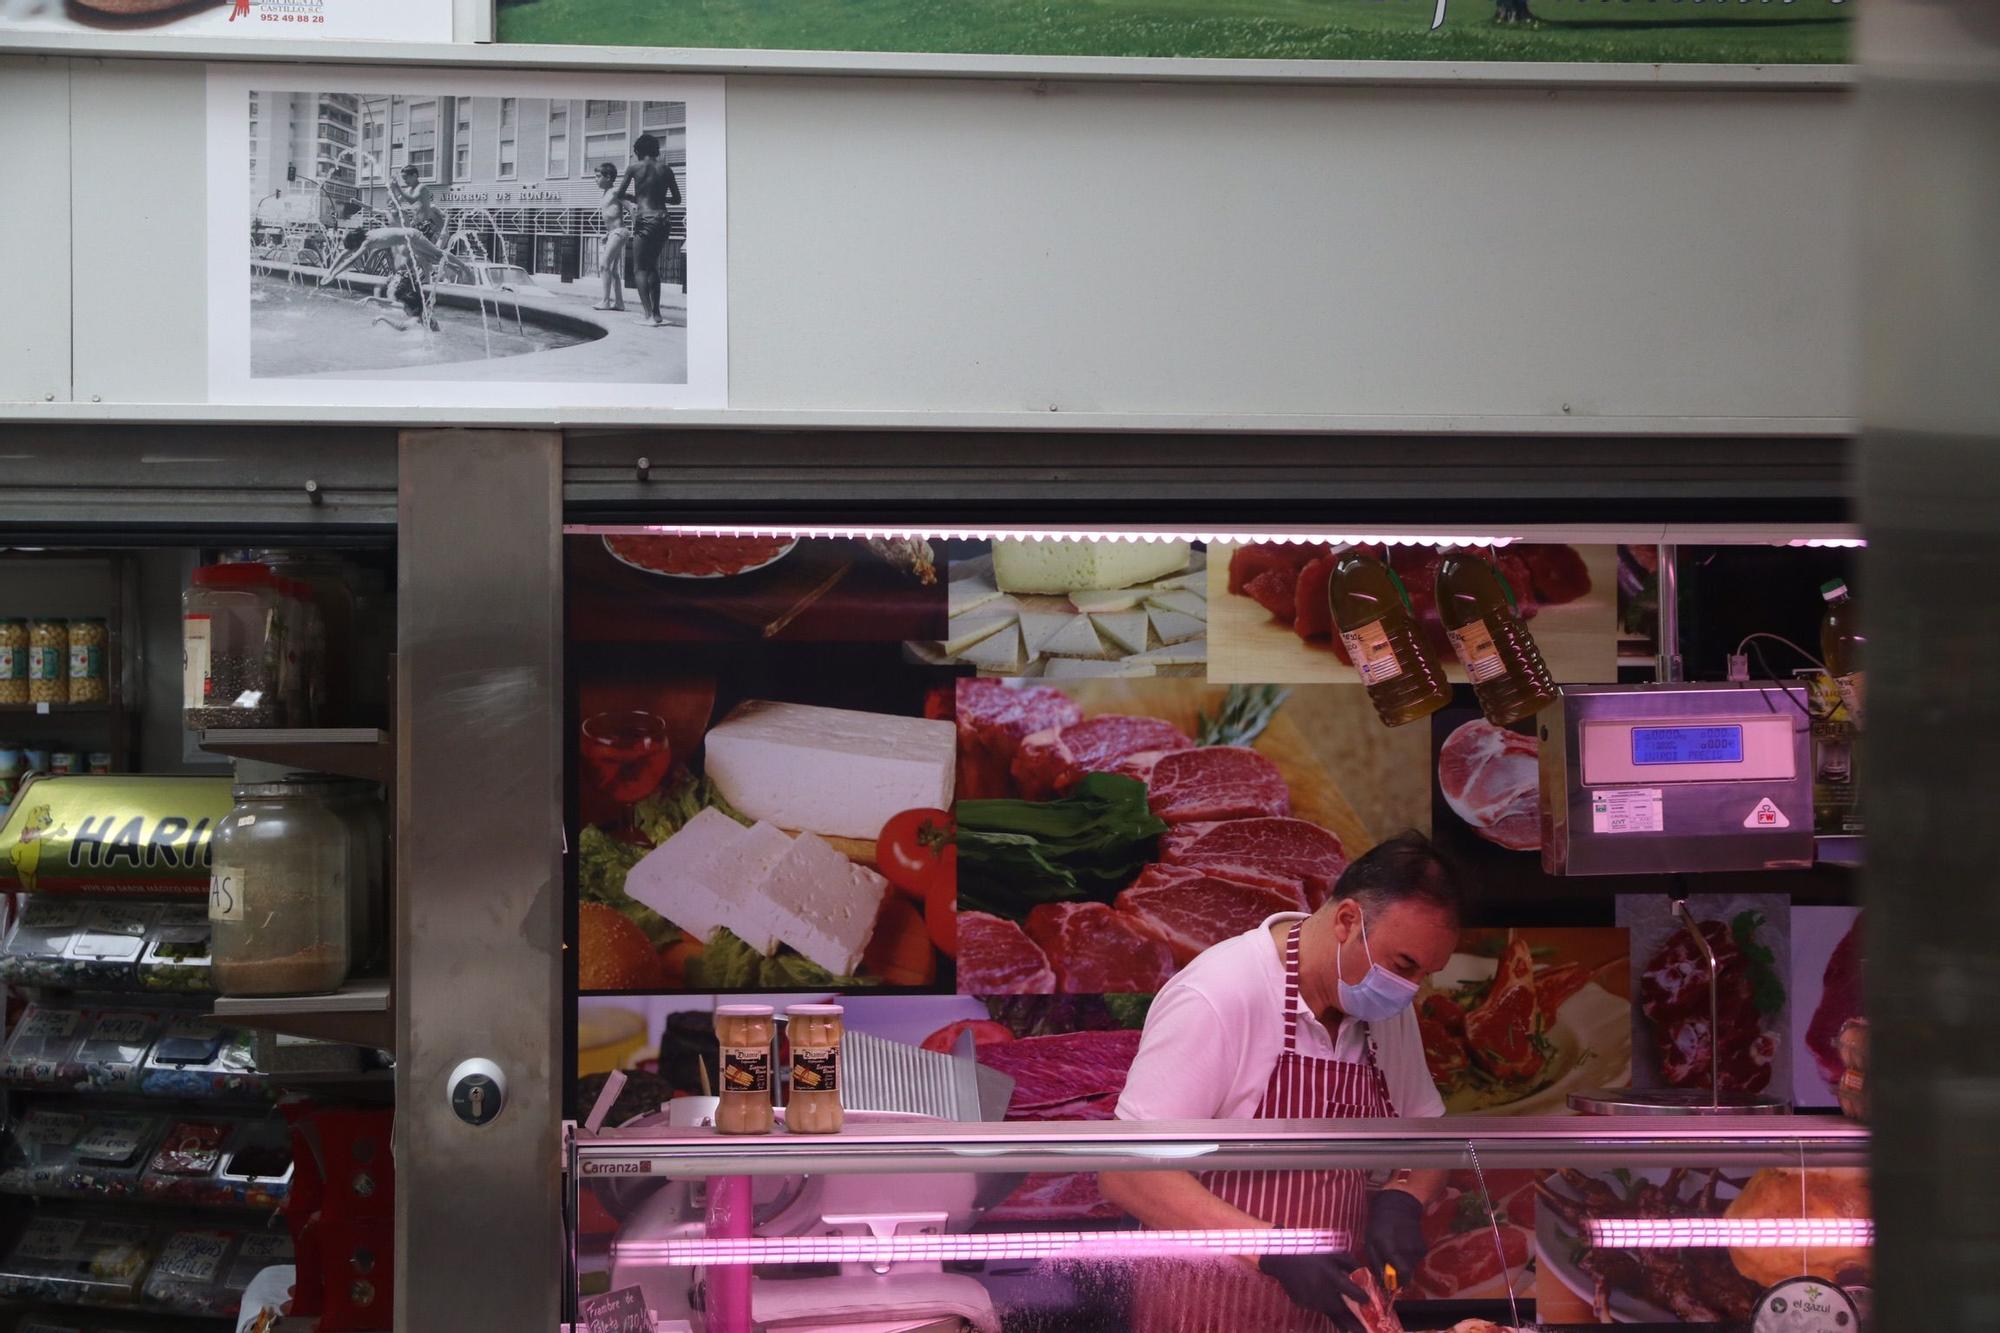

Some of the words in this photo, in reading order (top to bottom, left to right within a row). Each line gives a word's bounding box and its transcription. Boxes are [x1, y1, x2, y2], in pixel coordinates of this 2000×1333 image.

[440, 191, 488, 202] AHORROS
[496, 190, 511, 202] DE
[520, 190, 562, 202] RONDA
[1760, 813, 1774, 822] FW
[68, 815, 212, 868] HARI
[210, 874, 236, 914] AS
[583, 1161, 638, 1174] Carranza
[1793, 1300, 1802, 1309] el
[1803, 1302, 1831, 1314] gazul
